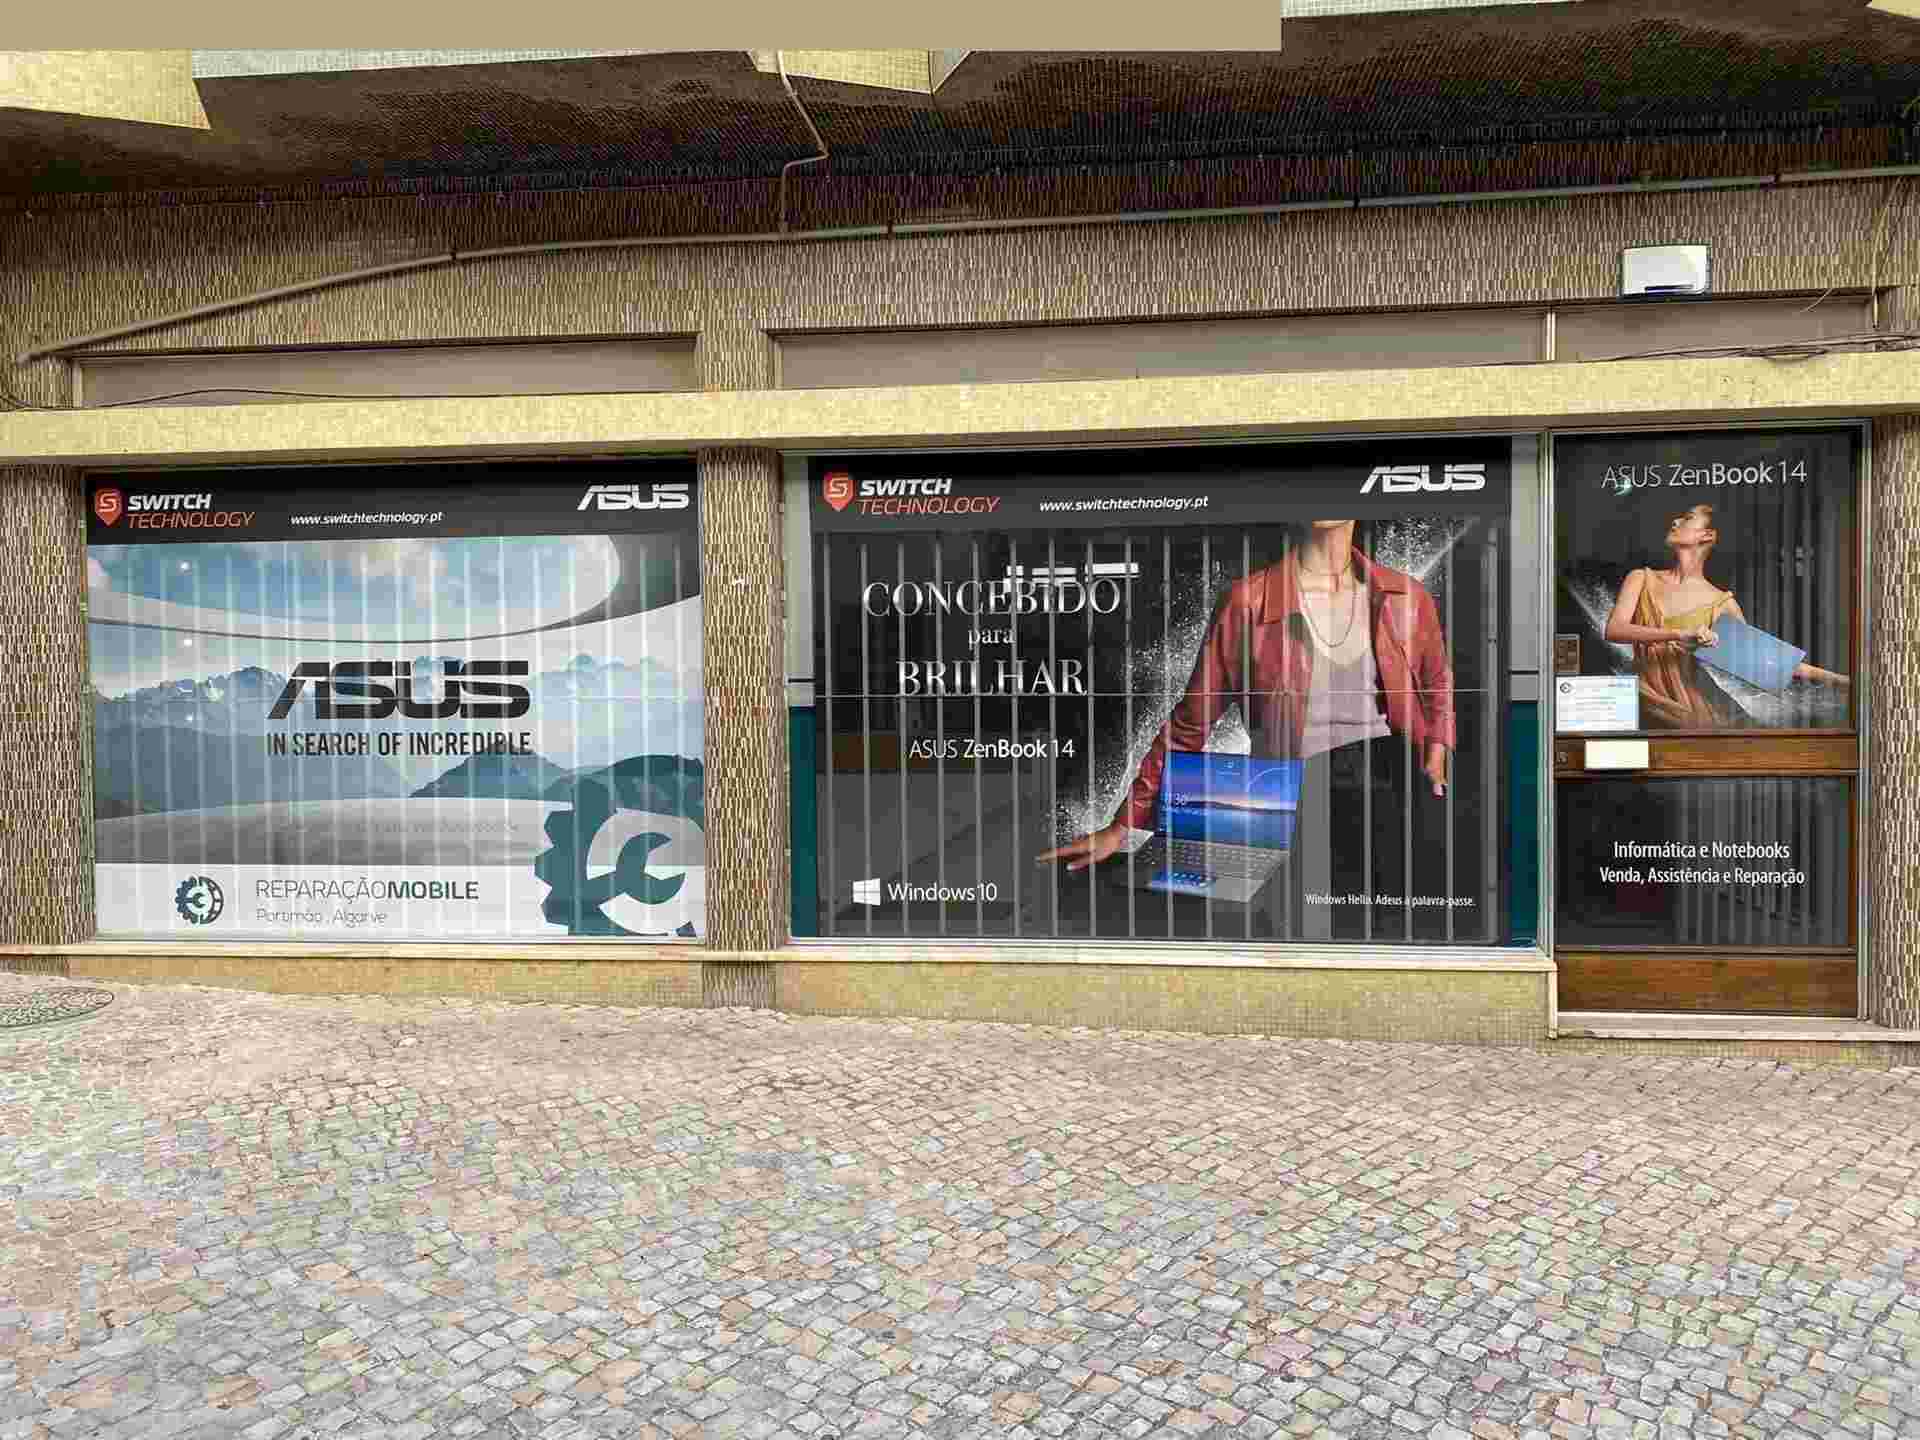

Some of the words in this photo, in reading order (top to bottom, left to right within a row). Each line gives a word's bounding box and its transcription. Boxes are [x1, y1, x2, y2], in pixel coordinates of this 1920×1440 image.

[1360, 464, 1486, 494] ASUS
[1601, 463, 1662, 489] ASUS
[1668, 462, 1773, 487] ZenBook
[1778, 460, 1808, 483] 14
[859, 478, 953, 496] SWITCH
[127, 493, 212, 511] SWITCH
[577, 484, 689, 511] ASUS
[859, 497, 1001, 515] TECHNOLOGY
[1039, 496, 1209, 512] www.switchtechnology.pt
[128, 511, 256, 528] TECHNOLOGY
[290, 511, 443, 525] www.switchtechnology.pt
[863, 580, 1121, 617] CONCEBIDO
[967, 629, 1015, 650] para
[896, 659, 1088, 696] BRILHAR
[268, 660, 531, 720] ASUS
[267, 733, 286, 756] IN
[293, 732, 370, 756] SEARCH
[378, 732, 403, 755] OF
[409, 732, 531, 755] INCREDIBLE
[909, 740, 958, 758] ASUS
[963, 739, 1048, 758] ZenBook
[1051, 739, 1075, 758] 14
[1614, 841, 1696, 859] Informática
[1700, 846, 1709, 858] e
[1712, 841, 1791, 859] Notebooks
[1600, 867, 1645, 885] Venda,
[1648, 867, 1720, 884] Assistência
[1723, 870, 1732, 884] e
[1735, 868, 1805, 887] Reparação
[256, 876, 479, 904] REPARAÇÃOMOBILE
[888, 882, 976, 901] Windows
[977, 882, 998, 901] 10
[1304, 893, 1346, 905] Windows
[1375, 894, 1401, 905] Adeus
